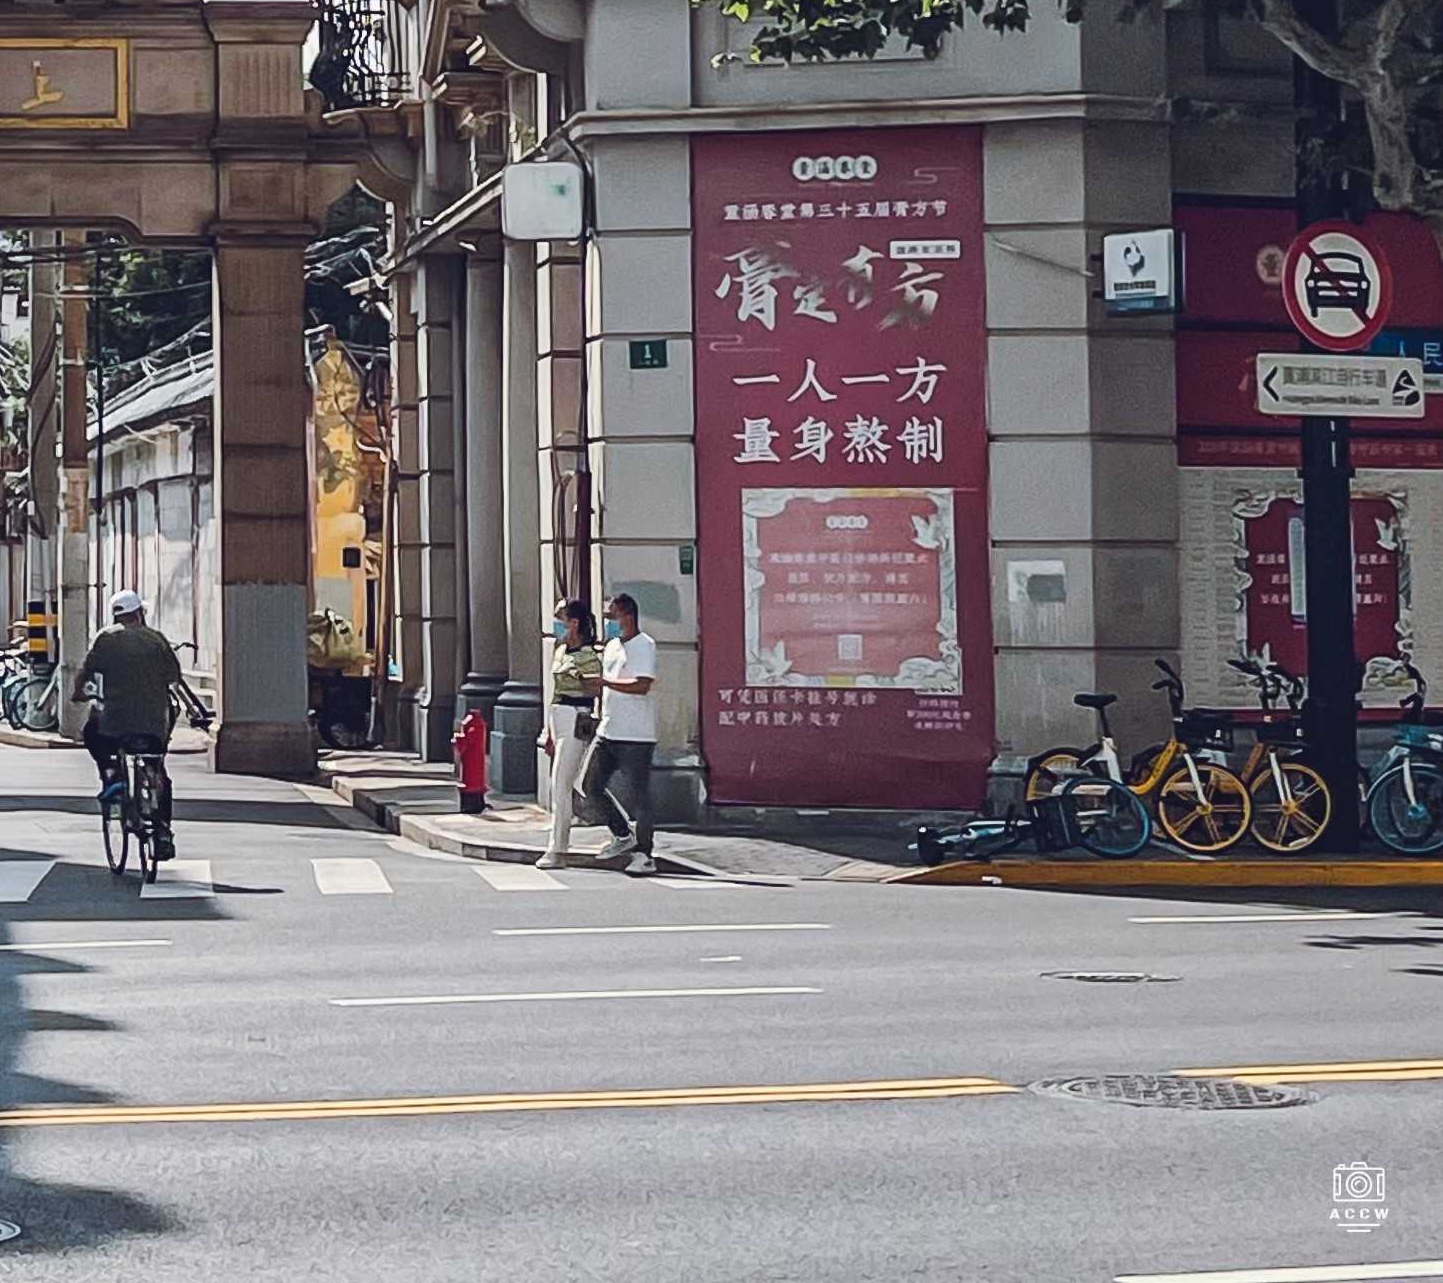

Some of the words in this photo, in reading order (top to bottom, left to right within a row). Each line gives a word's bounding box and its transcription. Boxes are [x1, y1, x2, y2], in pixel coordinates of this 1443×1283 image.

[733, 356, 947, 404] 一人一方
[733, 414, 945, 464] 量身熬制
